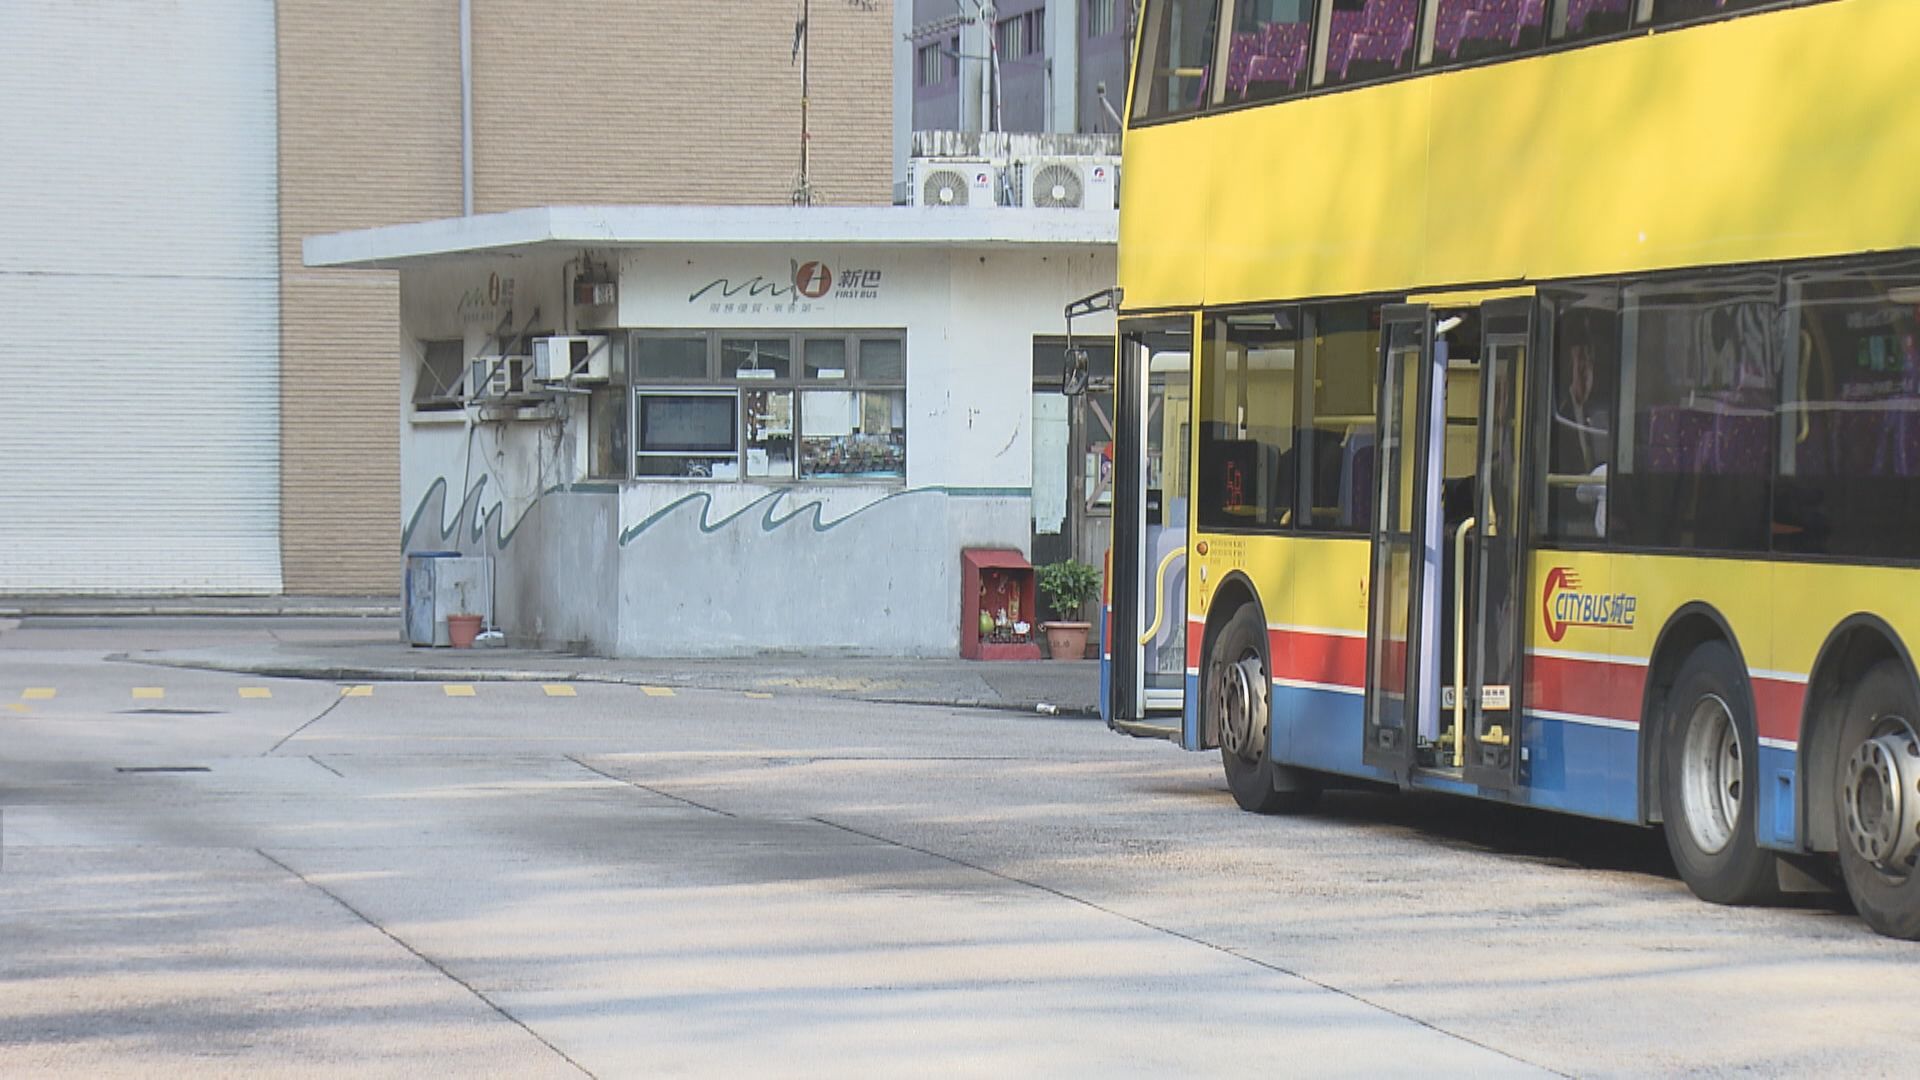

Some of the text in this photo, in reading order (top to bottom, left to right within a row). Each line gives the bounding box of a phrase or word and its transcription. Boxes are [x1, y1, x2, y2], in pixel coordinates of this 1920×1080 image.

[838, 269, 882, 288] 新巴
[835, 290, 878, 299] FIRST BUS
[1555, 592, 1611, 623] CITYBUS
[1611, 592, 1637, 625] 城巴
